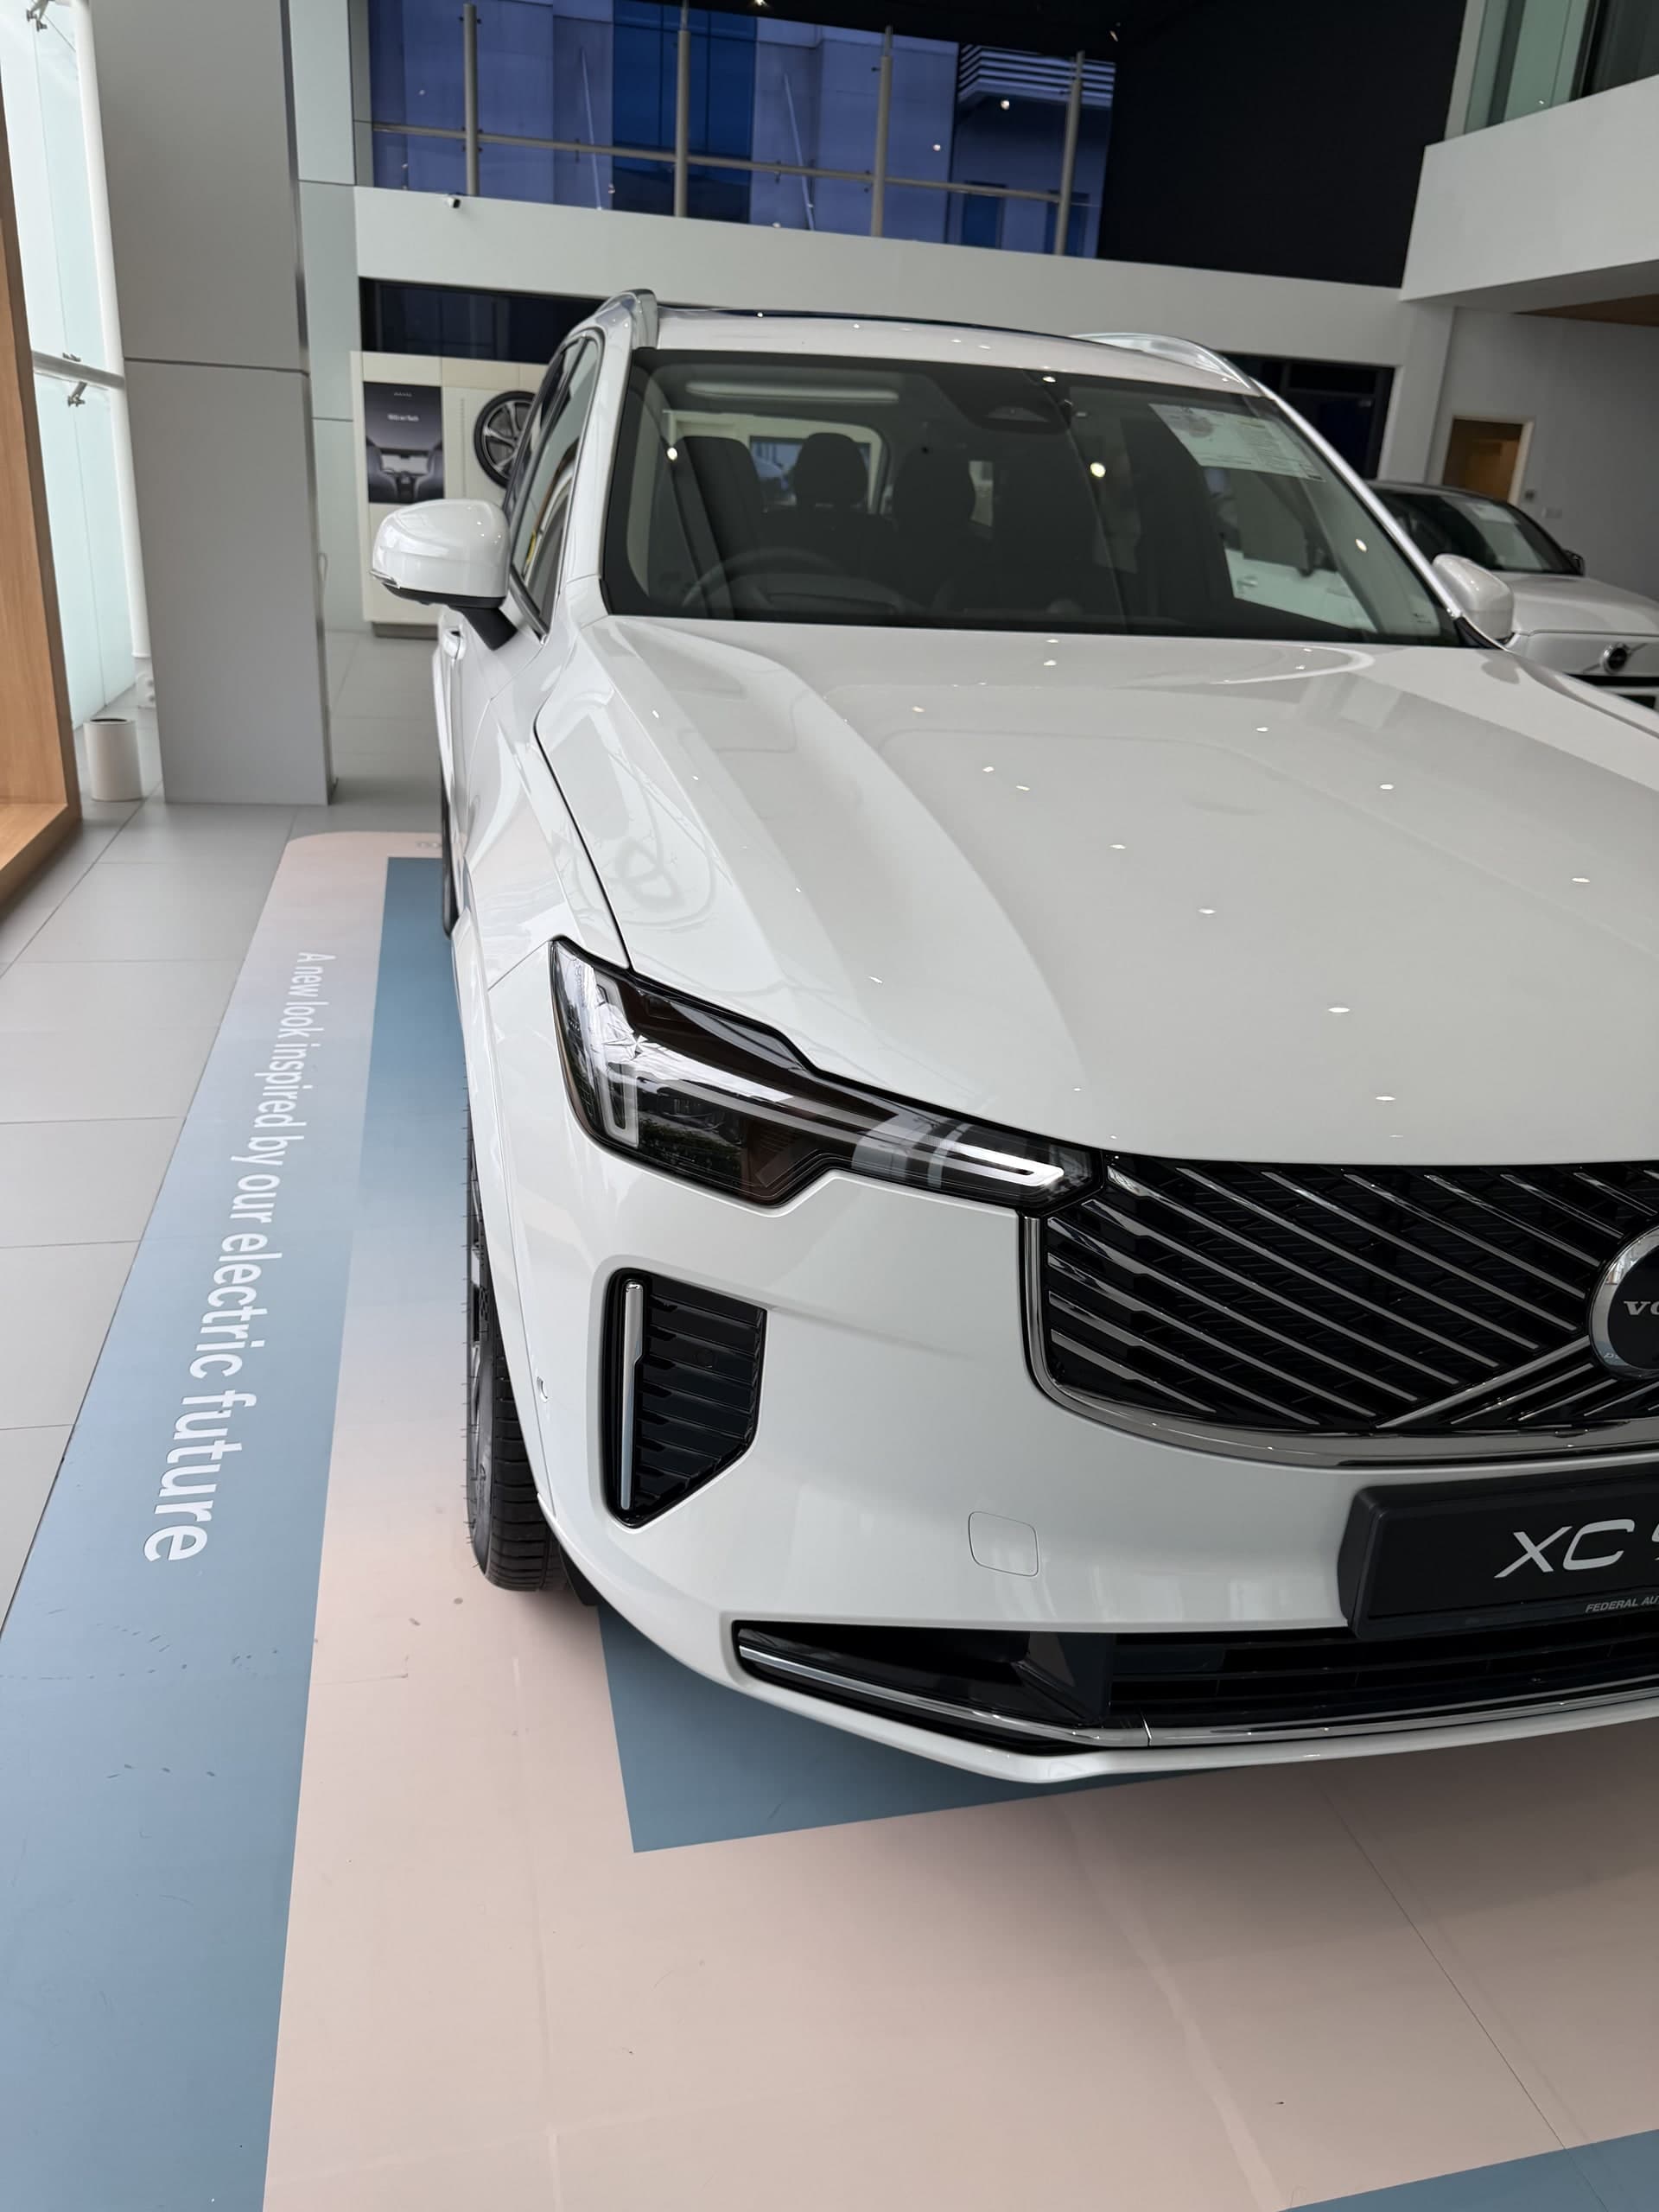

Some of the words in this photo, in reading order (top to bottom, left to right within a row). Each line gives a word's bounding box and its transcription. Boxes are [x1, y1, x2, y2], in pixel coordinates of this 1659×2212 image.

[297, 952, 336, 963] A
[288, 966, 323, 997] new
[277, 1001, 329, 1039] look
[253, 1043, 321, 1128] inspired
[230, 1135, 305, 1166] by
[229, 1173, 281, 1224] our
[189, 1233, 283, 1379] electric
[143, 1389, 257, 1562] future
[1494, 1519, 1635, 1578] XC
[1585, 1598, 1639, 1613] FEDERAL
[1642, 1595, 1659, 1606] AU
